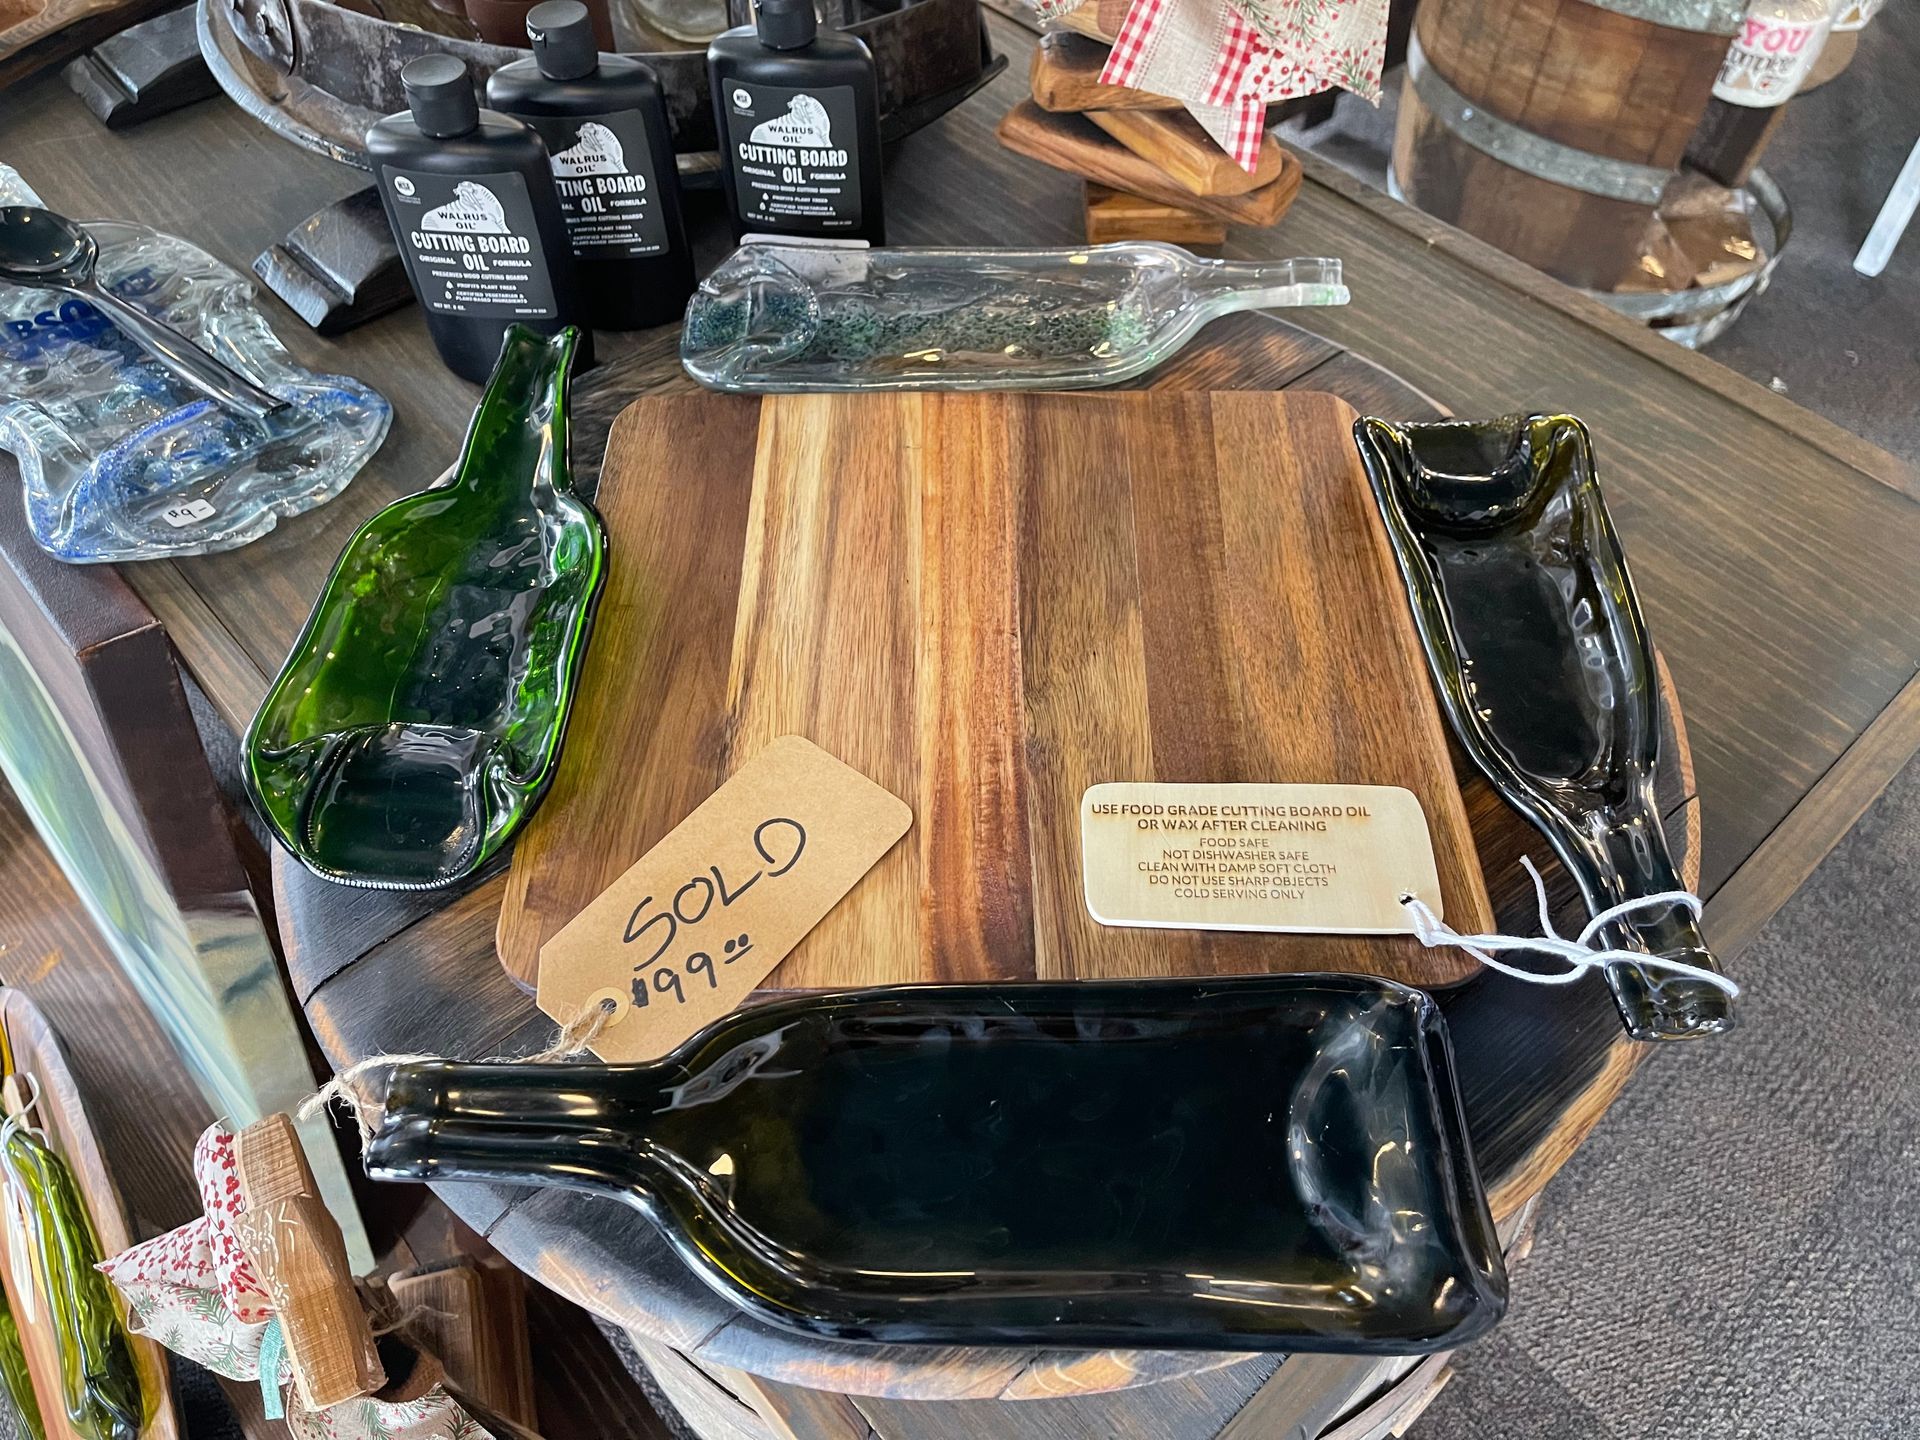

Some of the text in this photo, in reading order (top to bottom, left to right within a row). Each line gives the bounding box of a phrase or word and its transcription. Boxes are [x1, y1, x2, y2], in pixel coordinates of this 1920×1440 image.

[1743, 15, 1812, 54] YOU
[768, 125, 814, 135] WALRUS
[559, 154, 607, 165] WALRUS
[738, 143, 848, 167] CUTTING BOARD
[576, 165, 593, 174] OIL
[742, 166, 776, 177] ORIGINAL
[782, 167, 806, 184] OIL
[596, 174, 646, 194] BOARD
[581, 196, 606, 213] OIL
[610, 198, 647, 207] FORMULA
[437, 211, 488, 221] WALRUS
[456, 222, 475, 230] OIL
[411, 231, 530, 254] CUTTING BOARD
[419, 253, 532, 271] ORIGINAL OIL FORMULA
[1092, 804, 1371, 817] USE FOOD GRADE CUTTING BOARD OIL
[1138, 818, 1327, 832] OR WAX AFTER CLEANING
[1200, 837, 1269, 848] FOOD SAFE
[1163, 849, 1309, 861] NOT DISHWASHER SAFE
[1138, 861, 1337, 874] CLEAN WITH DAMP SOFT CLOTH
[1149, 874, 1329, 887] DO NOT USE SHARP OBJECTS
[623, 817, 806, 972] SOLD
[1174, 888, 1305, 900] COLD SERVING ONLY
